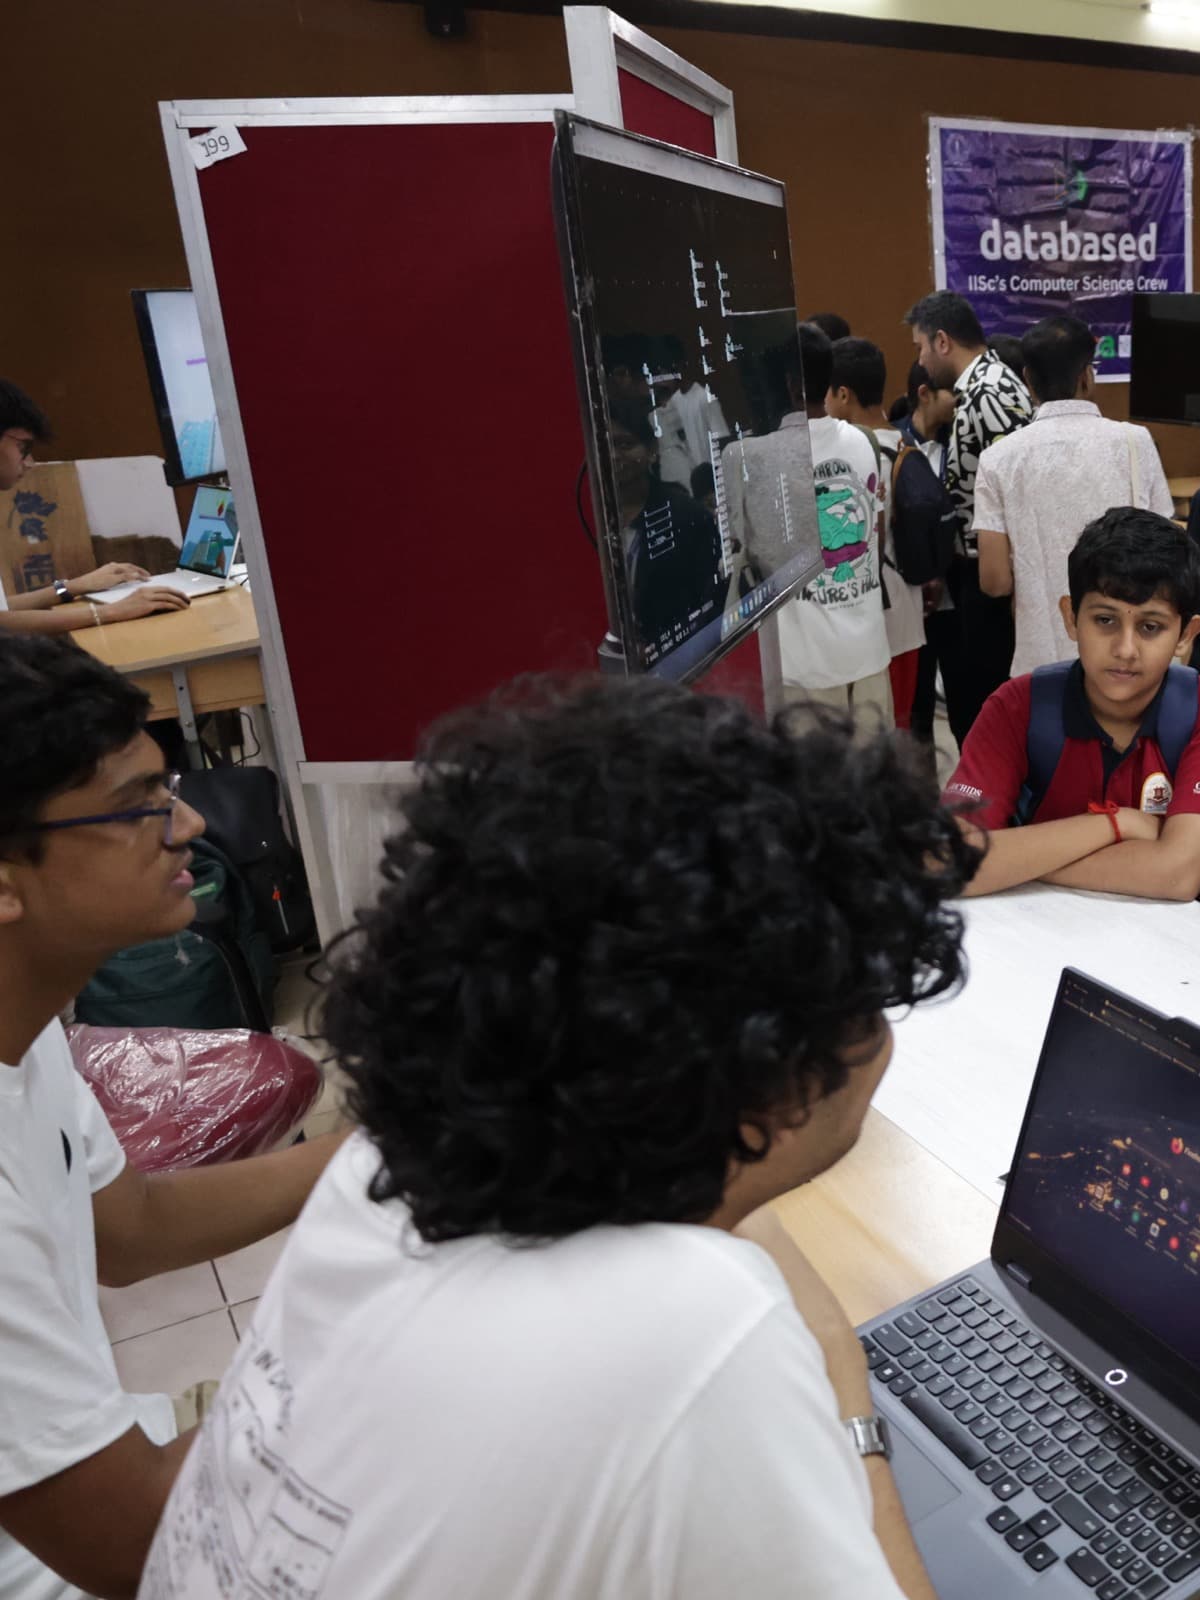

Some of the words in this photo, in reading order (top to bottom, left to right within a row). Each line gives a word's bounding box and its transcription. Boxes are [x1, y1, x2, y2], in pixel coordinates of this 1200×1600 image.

[199, 136, 230, 157] 199
[979, 218, 1158, 262] databased
[968, 274, 1007, 292] IISc's
[1010, 275, 1079, 295] Computer
[1082, 275, 1134, 292] Science
[1137, 276, 1168, 292] Crew
